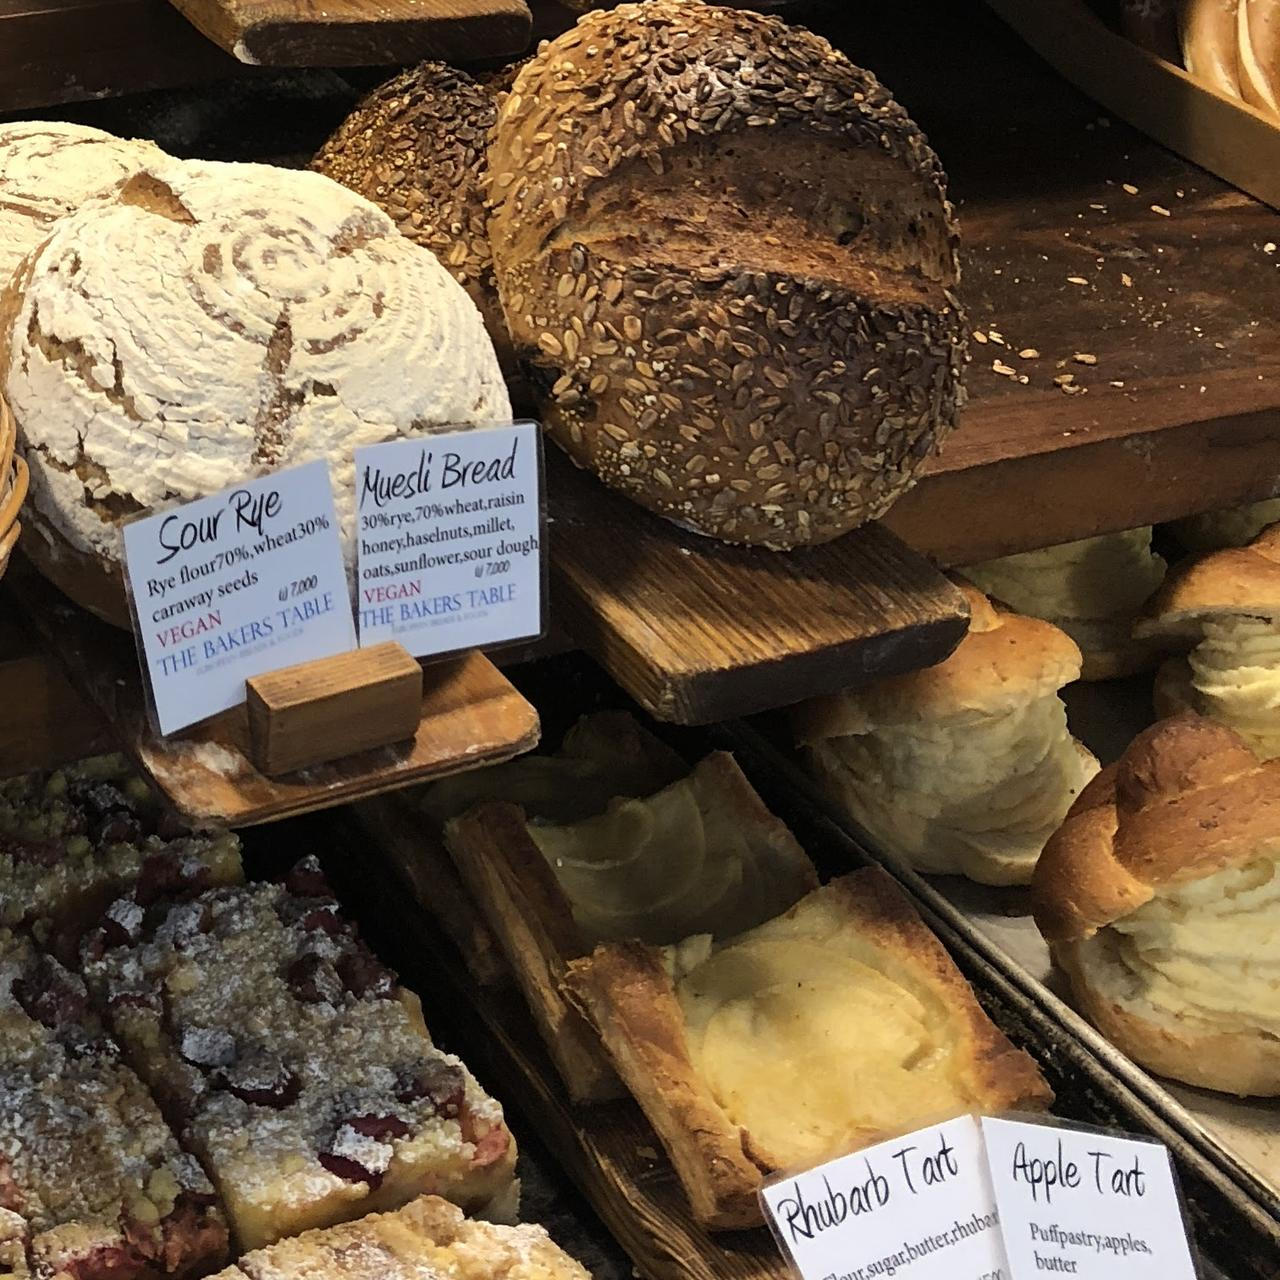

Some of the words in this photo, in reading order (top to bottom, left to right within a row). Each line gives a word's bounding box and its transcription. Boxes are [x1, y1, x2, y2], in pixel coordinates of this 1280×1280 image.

[359, 448, 433, 511] Muesli
[441, 436, 519, 490] Bread
[156, 508, 225, 565] Sour
[228, 489, 283, 536] Rye
[496, 534, 539, 558] dough
[146, 576, 177, 598] Rye
[152, 588, 215, 623] caraway
[217, 569, 259, 597] seeds
[359, 607, 395, 628] THE
[400, 593, 463, 622] BAKERS
[465, 583, 517, 608] TABLE
[363, 579, 423, 605] VEGAN
[155, 608, 223, 648] VEGAN
[156, 646, 198, 677] THE
[202, 619, 274, 661] BAKERS
[276, 591, 335, 629] TABLE
[776, 1156, 890, 1245] Rhubarb
[891, 1132, 959, 1195] Tart
[1012, 1137, 1081, 1204] Apple
[1087, 1151, 1146, 1197] Tart
[1033, 1250, 1078, 1274] butter
